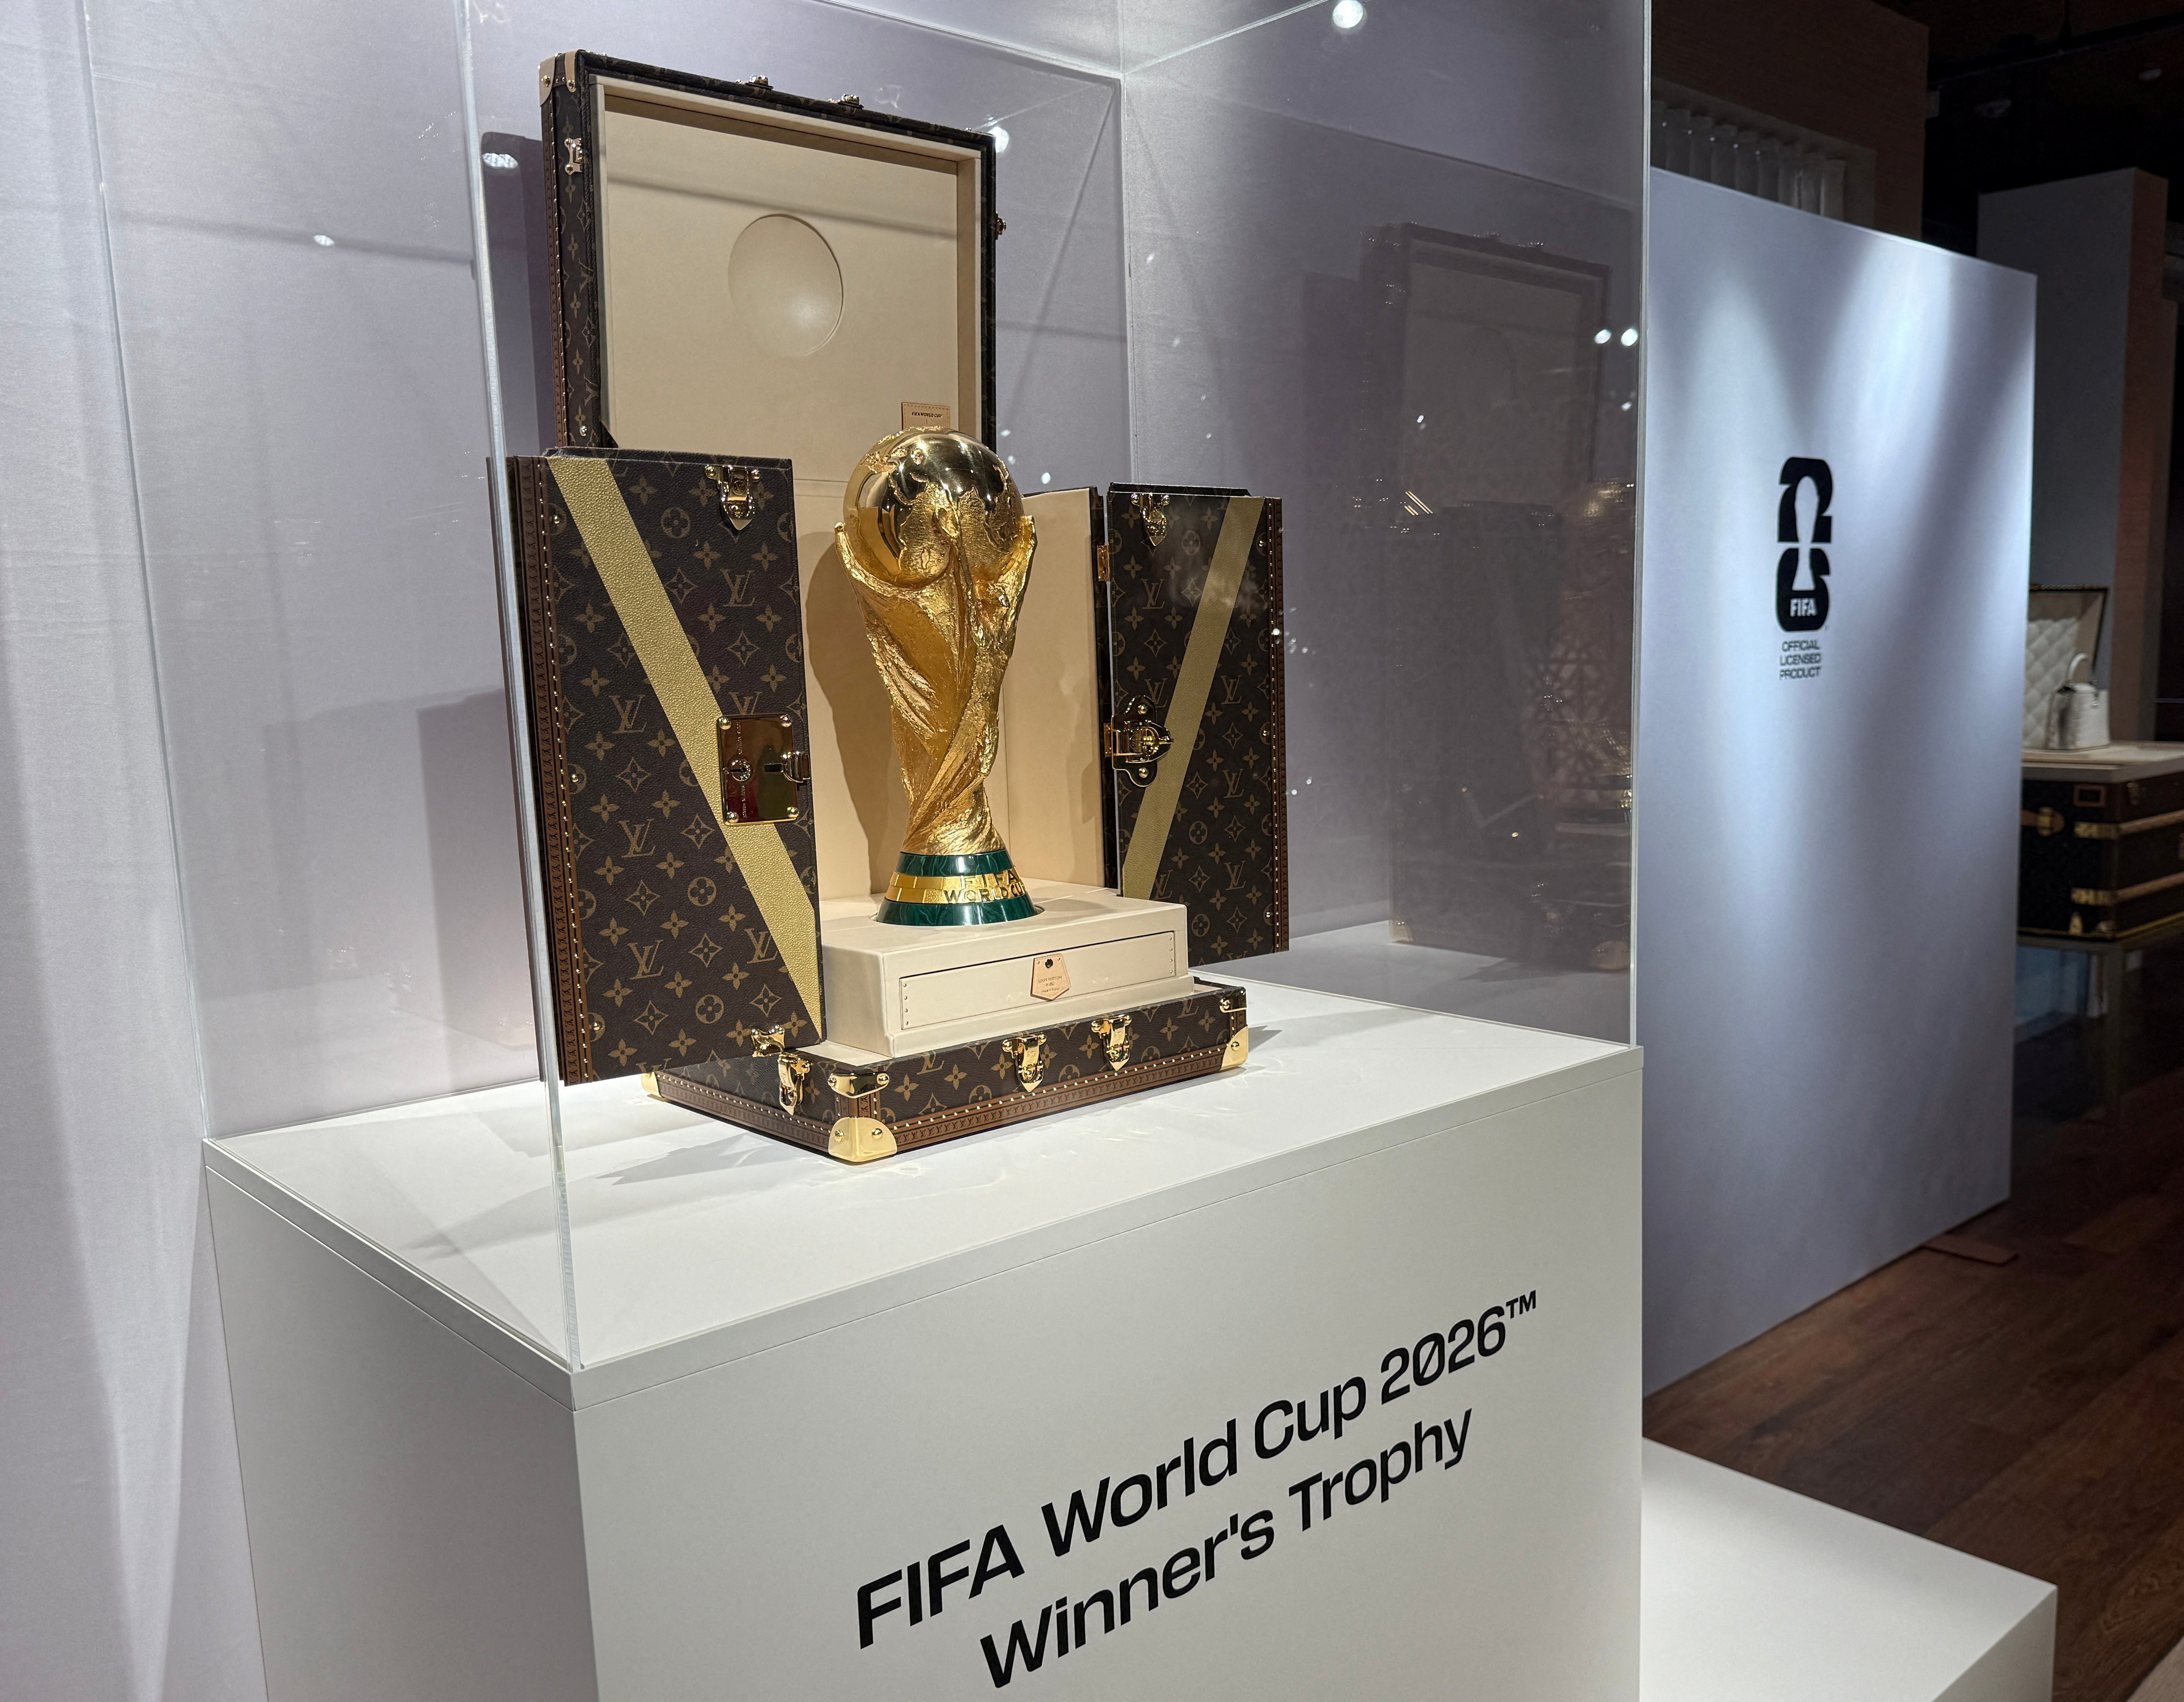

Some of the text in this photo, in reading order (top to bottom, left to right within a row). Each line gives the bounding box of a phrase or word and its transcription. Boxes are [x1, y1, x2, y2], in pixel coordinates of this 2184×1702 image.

[1790, 598, 1817, 617] FIFA
[1782, 640, 1820, 652] OFFICIAL
[1779, 652, 1821, 666] LICENSED
[1779, 665, 1821, 680] PRODUCT
[960, 870, 1018, 888] FIFA
[943, 885, 1008, 903] WORLD
[857, 1290, 1536, 1649] FIFA World Cup 2026™
[980, 1408, 1472, 1688] Winner's Trophy
